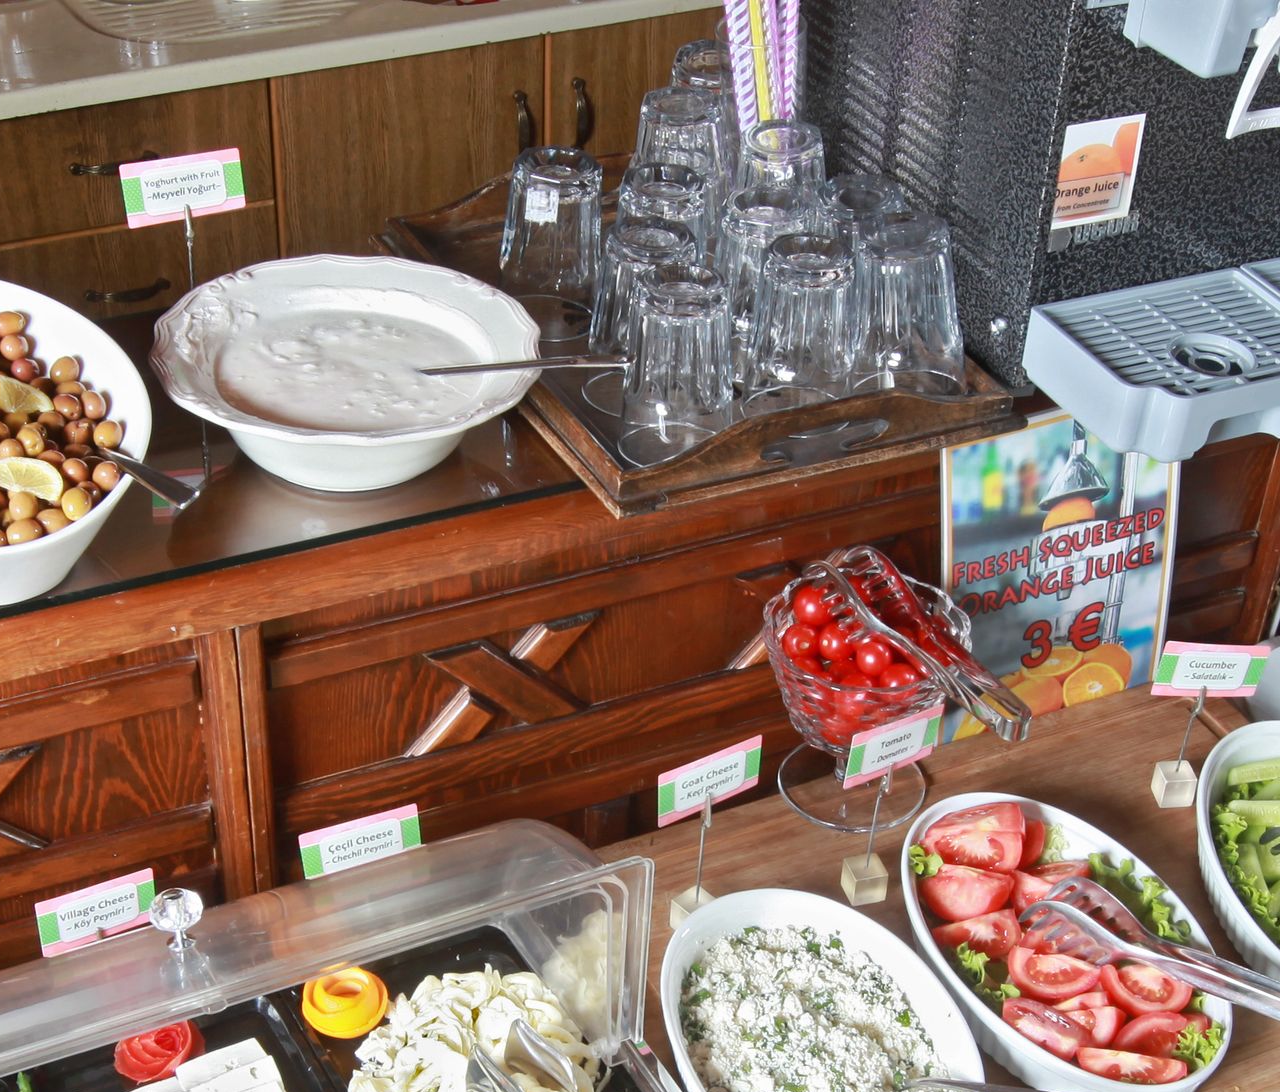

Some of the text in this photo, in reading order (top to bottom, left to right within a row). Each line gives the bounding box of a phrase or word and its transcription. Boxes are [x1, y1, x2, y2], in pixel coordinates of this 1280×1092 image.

[144, 169, 221, 190] Yoghurt with Fruit
[1093, 179, 1119, 193] Juice
[952, 508, 1165, 588] FRESH SQUEEZED
[959, 541, 1155, 618] ORANGE JUICE
[1020, 601, 1106, 669] 3 €
[1188, 660, 1237, 669] Cucumber
[1191, 672, 1227, 681] Salatalık
[880, 731, 912, 749] Tomato
[877, 745, 908, 763] Domates
[681, 762, 739, 789] Goat Cheese
[686, 785, 705, 800] Keçi
[328, 828, 394, 855] Çeçil Cheese
[332, 840, 393, 864] Chechil Peyniri
[59, 891, 135, 923] Village Cheese
[73, 905, 125, 931] Köy Peyniri
